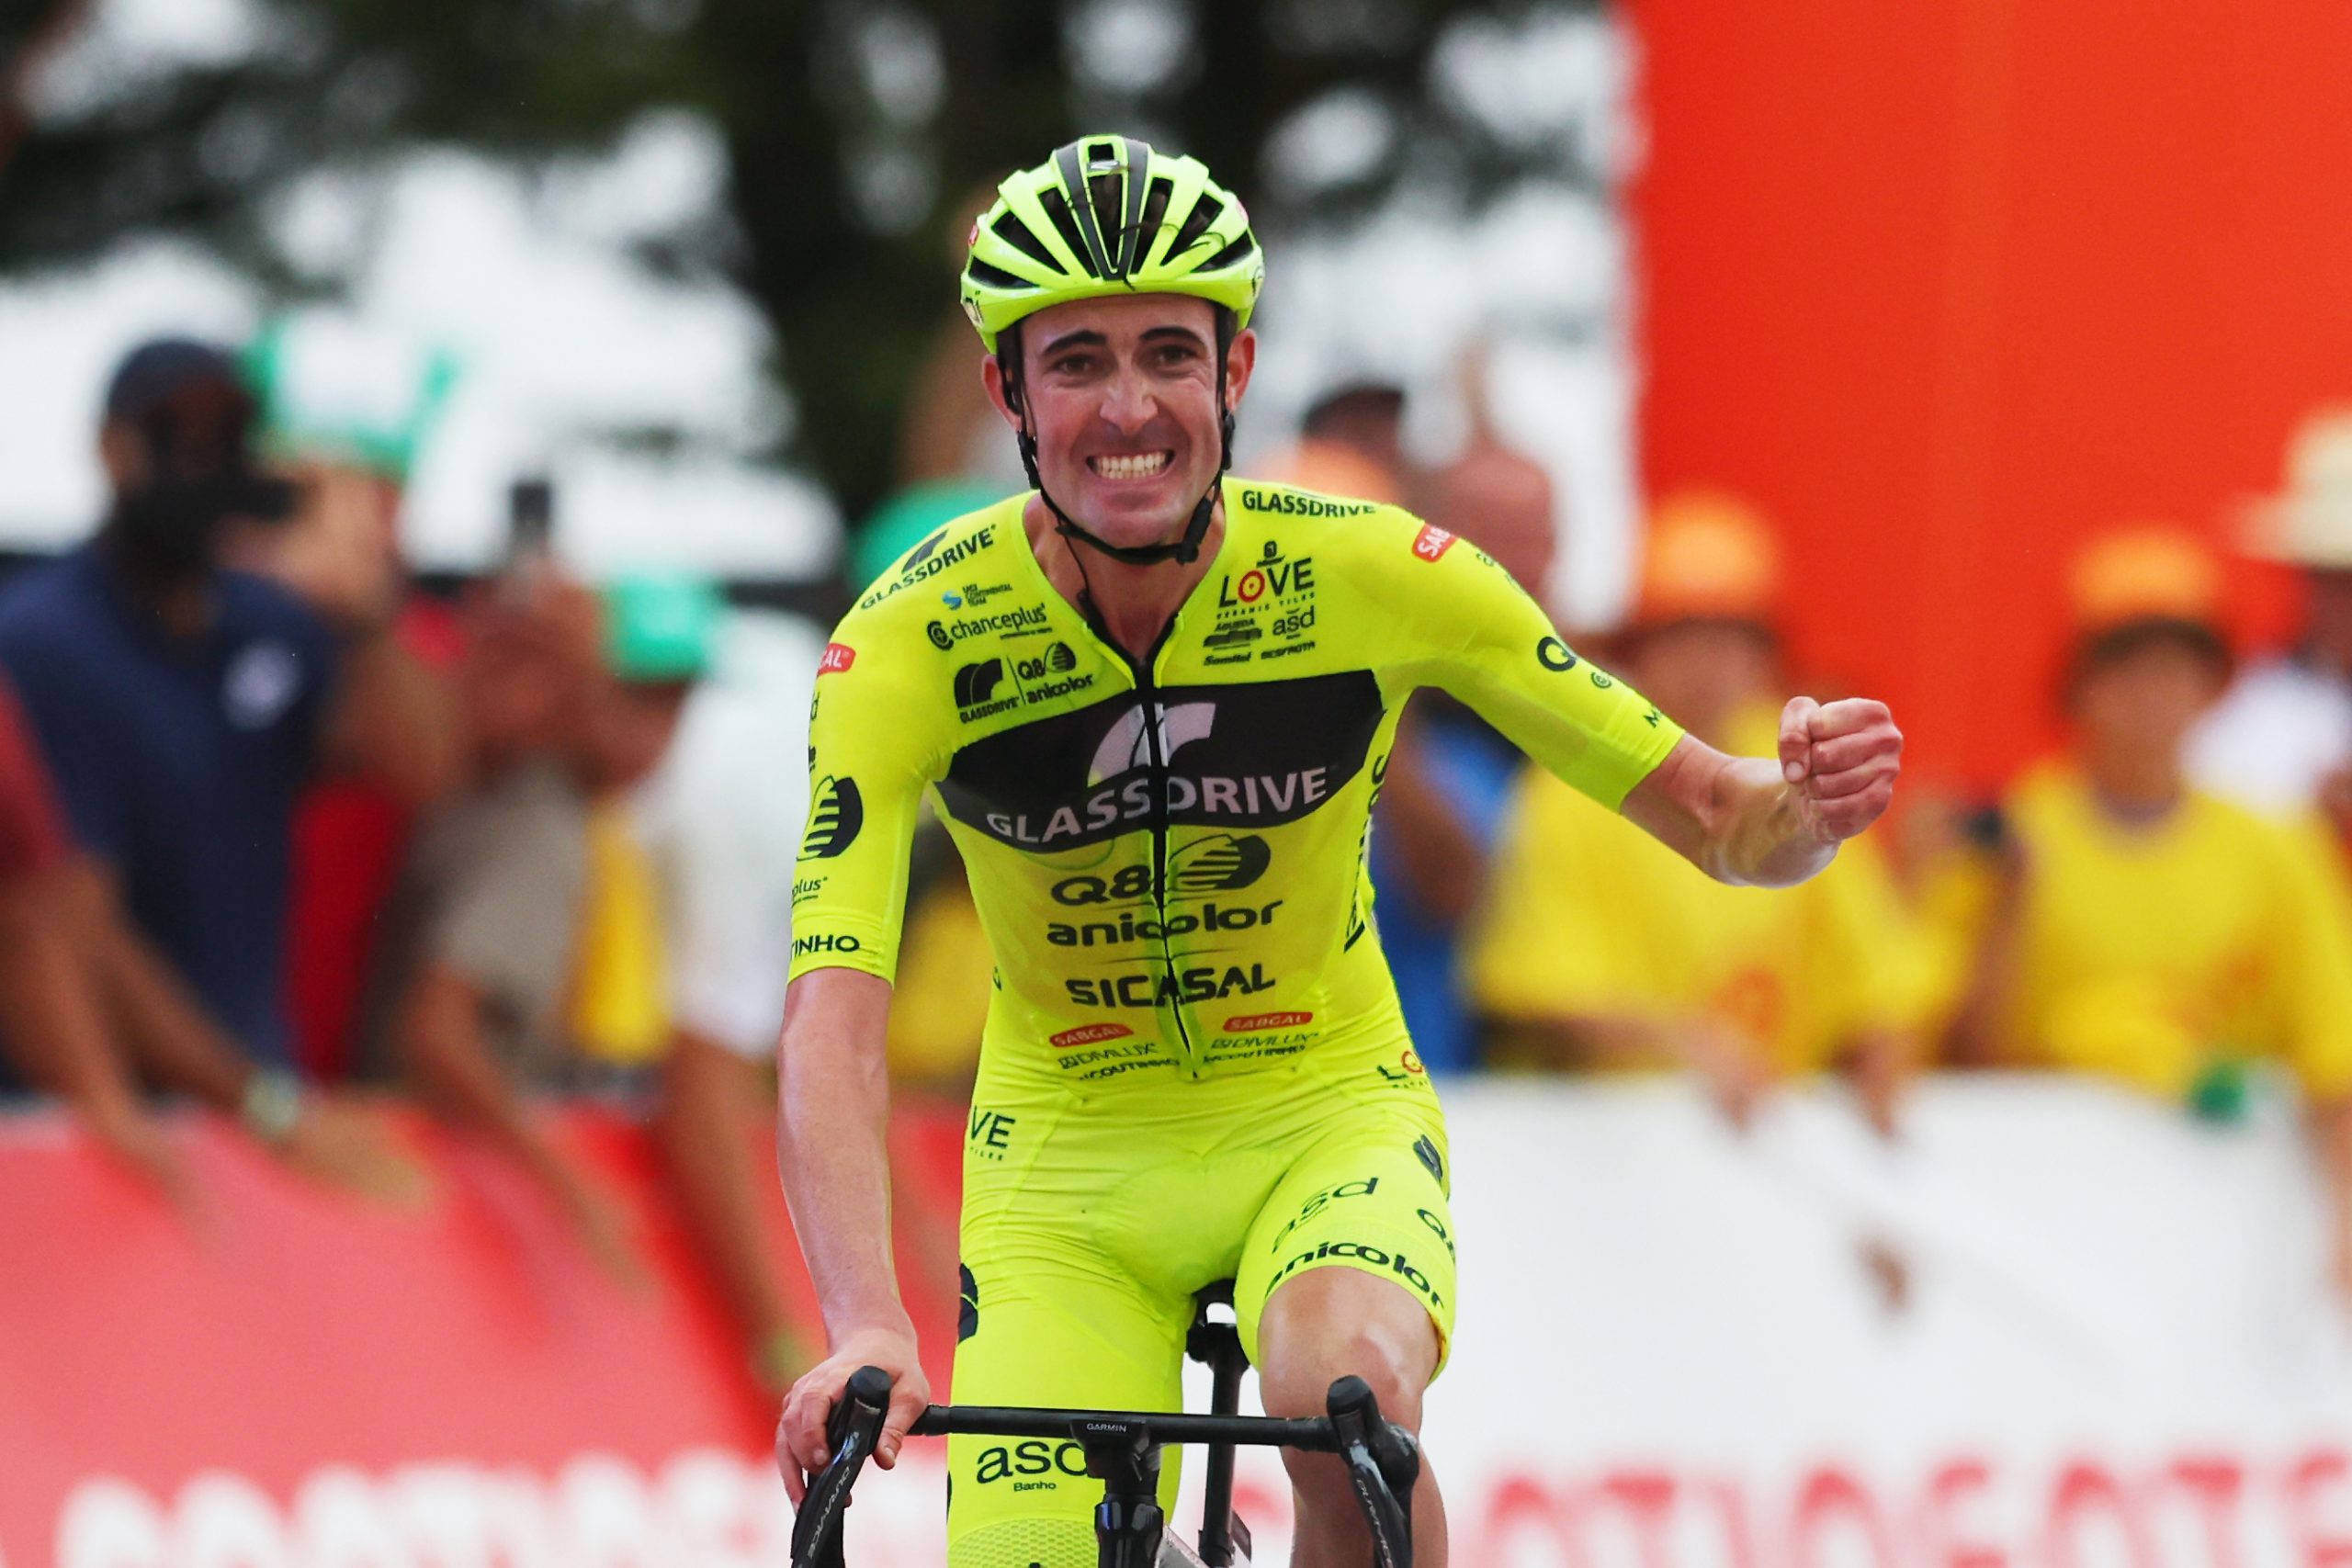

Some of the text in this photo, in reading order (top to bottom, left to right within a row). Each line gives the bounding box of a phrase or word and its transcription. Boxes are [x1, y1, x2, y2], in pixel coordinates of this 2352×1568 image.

[1242, 490, 1376, 517] GLASSDRIVE
[861, 525, 996, 610] GLASSDRIVE
[1219, 557, 1315, 608] LOVE
[1272, 604, 1315, 637] asd
[1017, 658, 1046, 682] Q8
[1028, 673, 1093, 705] anicolor
[959, 695, 1020, 724] GLASSDRIVE
[986, 767, 1327, 843] GLASSDRIVE
[1051, 864, 1152, 905] Q8
[1046, 899, 1283, 947] anicolor
[1066, 963, 1276, 1009] SICASAL
[1086, 1423, 1127, 1433] GARMIN
[1013, 1481, 1057, 1493] Banho
